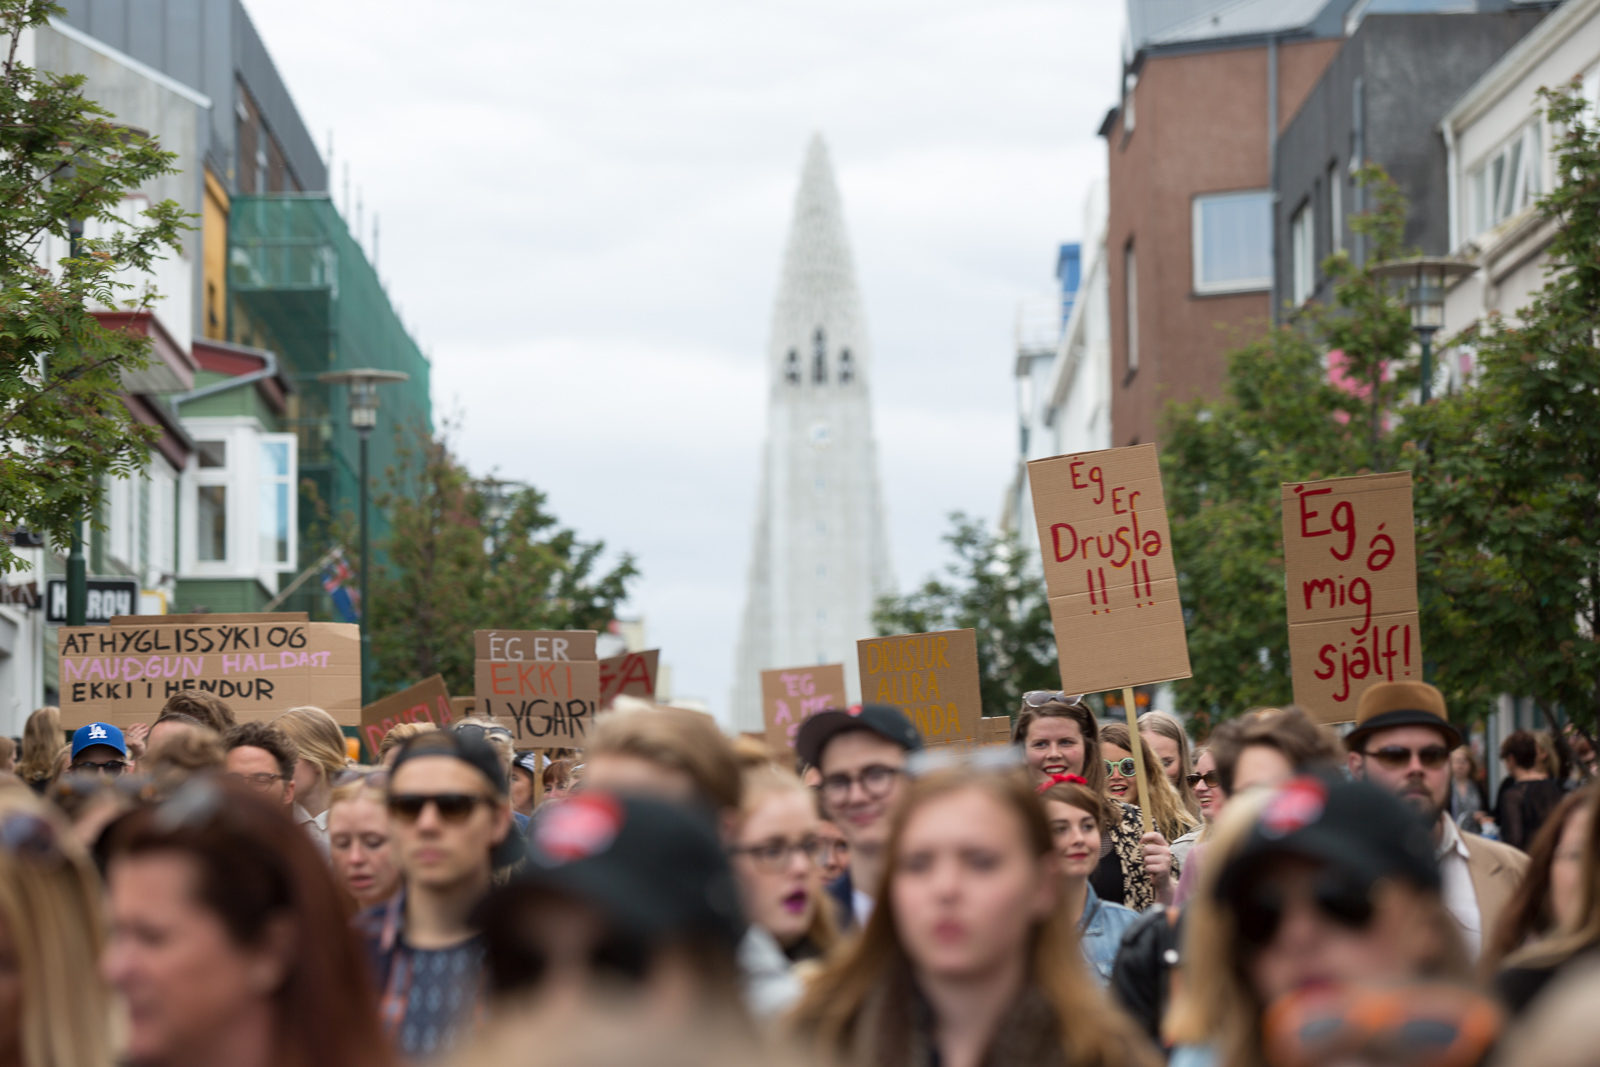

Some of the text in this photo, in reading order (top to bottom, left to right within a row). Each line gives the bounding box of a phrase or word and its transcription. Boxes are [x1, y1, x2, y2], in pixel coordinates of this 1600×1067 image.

[1069, 457, 1105, 505] Ég
[1111, 487, 1141, 515] Er
[1050, 511, 1162, 569] Drusla
[1293, 484, 1395, 572] Ég á
[52, 582, 131, 619] KROY
[1303, 575, 1373, 636] mig
[267, 626, 307, 649] OG
[488, 632, 570, 662] ÉG ER
[867, 636, 951, 675] DRUSLUR
[222, 651, 332, 675] HALDAST
[490, 663, 573, 699] EKKI
[1314, 624, 1412, 703] sjálf!
[72, 682, 132, 702] EKKI
[876, 671, 941, 705] ALLRA
[88, 723, 108, 740] LA
[365, 694, 453, 755] DSLA
[903, 701, 961, 736] NDA
